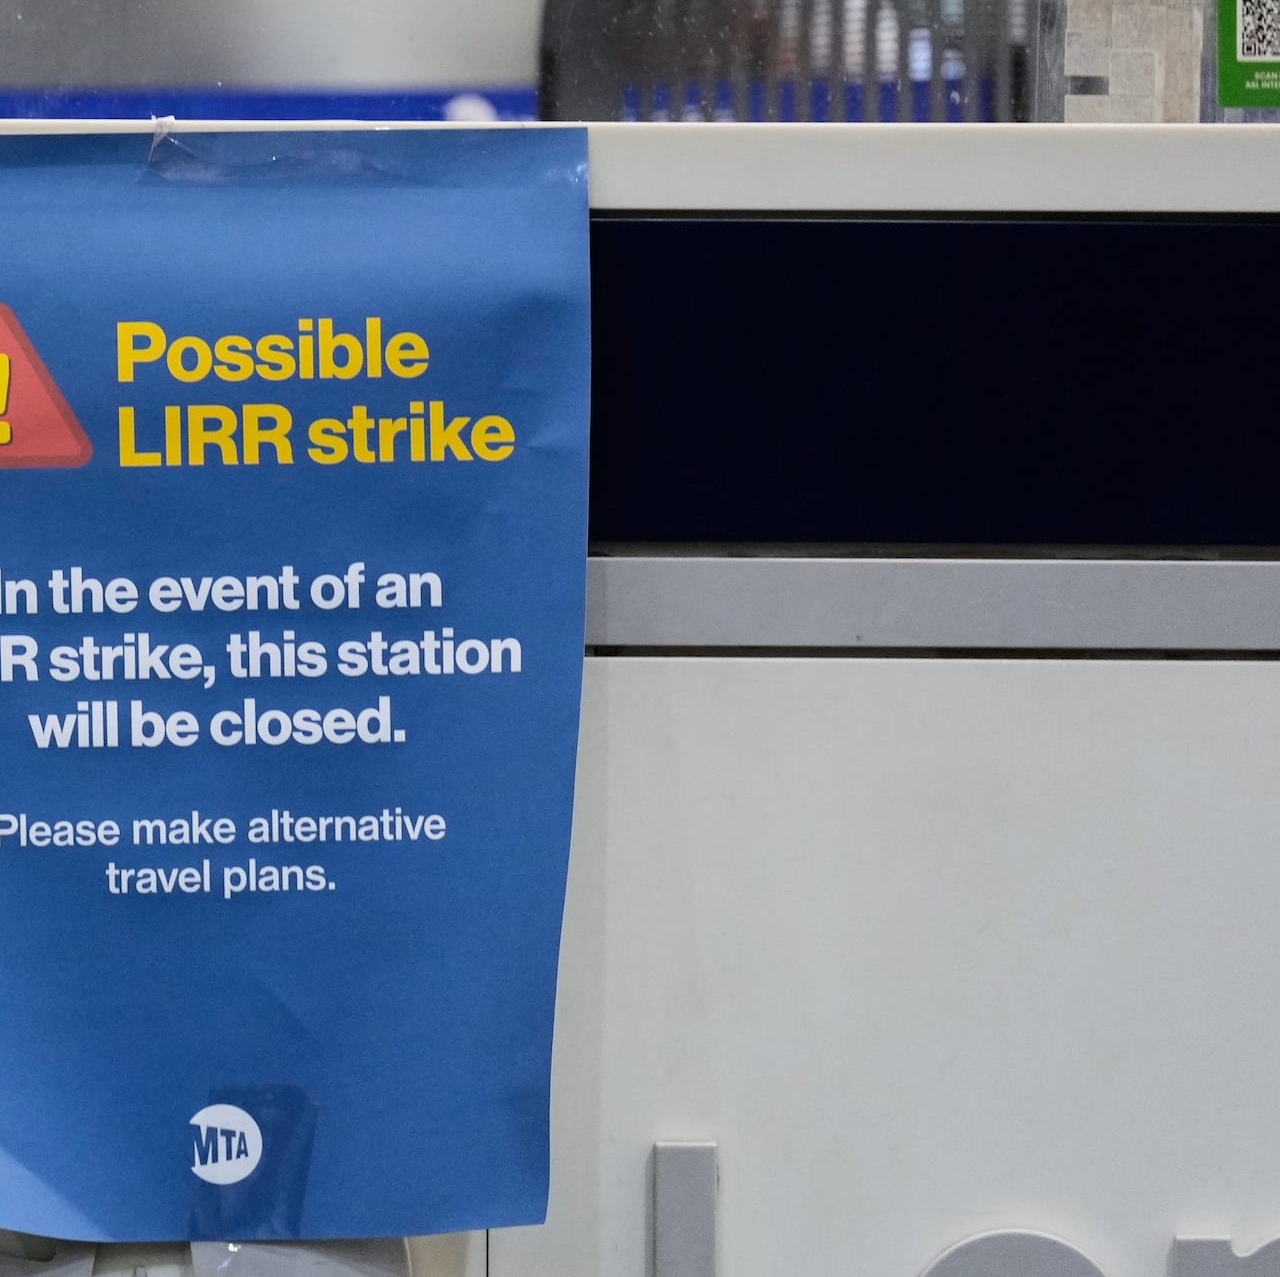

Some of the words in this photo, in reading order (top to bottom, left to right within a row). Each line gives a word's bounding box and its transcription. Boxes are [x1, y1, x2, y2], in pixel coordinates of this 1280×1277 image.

[118, 317, 430, 383] Possible
[119, 403, 293, 467] LIRR
[309, 401, 516, 465] strike
[48, 566, 139, 614] the
[148, 566, 300, 612] event
[310, 562, 365, 610] of
[375, 572, 442, 608] an
[49, 632, 216, 689] strike,
[226, 630, 328, 678] this
[337, 627, 522, 676] station
[28, 700, 119, 748] will
[130, 700, 200, 747] be
[210, 696, 406, 746] closed.
[132, 810, 236, 845] make
[247, 807, 446, 843] alternative
[105, 859, 211, 894] travel
[223, 858, 336, 899] plans.
